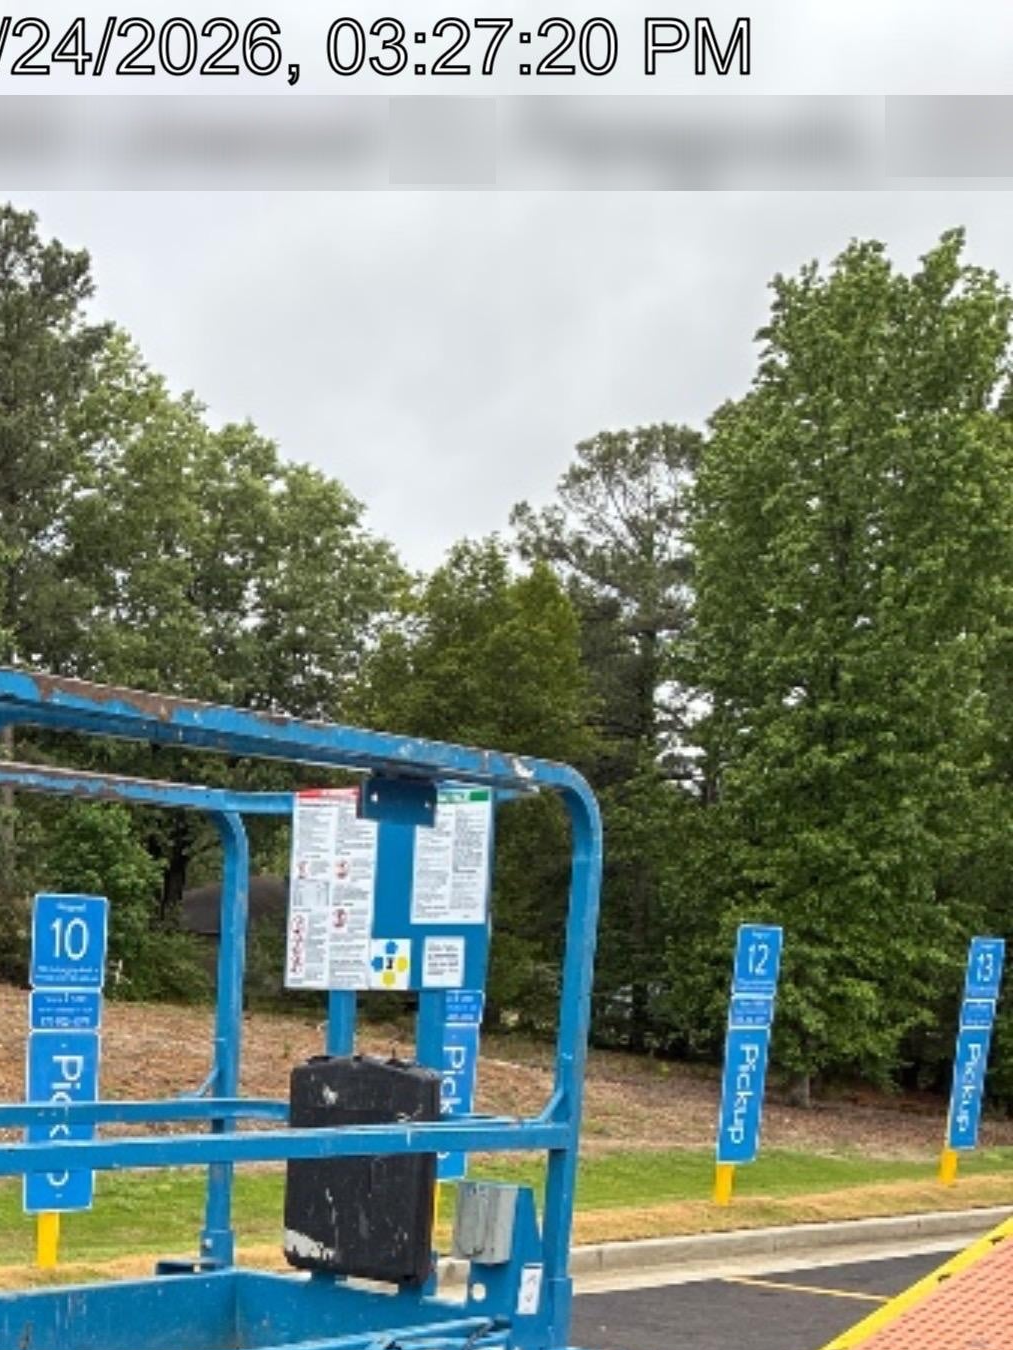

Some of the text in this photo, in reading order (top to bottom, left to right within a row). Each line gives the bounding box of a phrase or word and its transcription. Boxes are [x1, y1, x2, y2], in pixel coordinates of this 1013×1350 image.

[50, 917, 89, 961] 10
[748, 943, 769, 976] 12
[976, 952, 994, 983] 13
[726, 1042, 760, 1145] Pickup
[956, 1042, 982, 1133] Pickup
